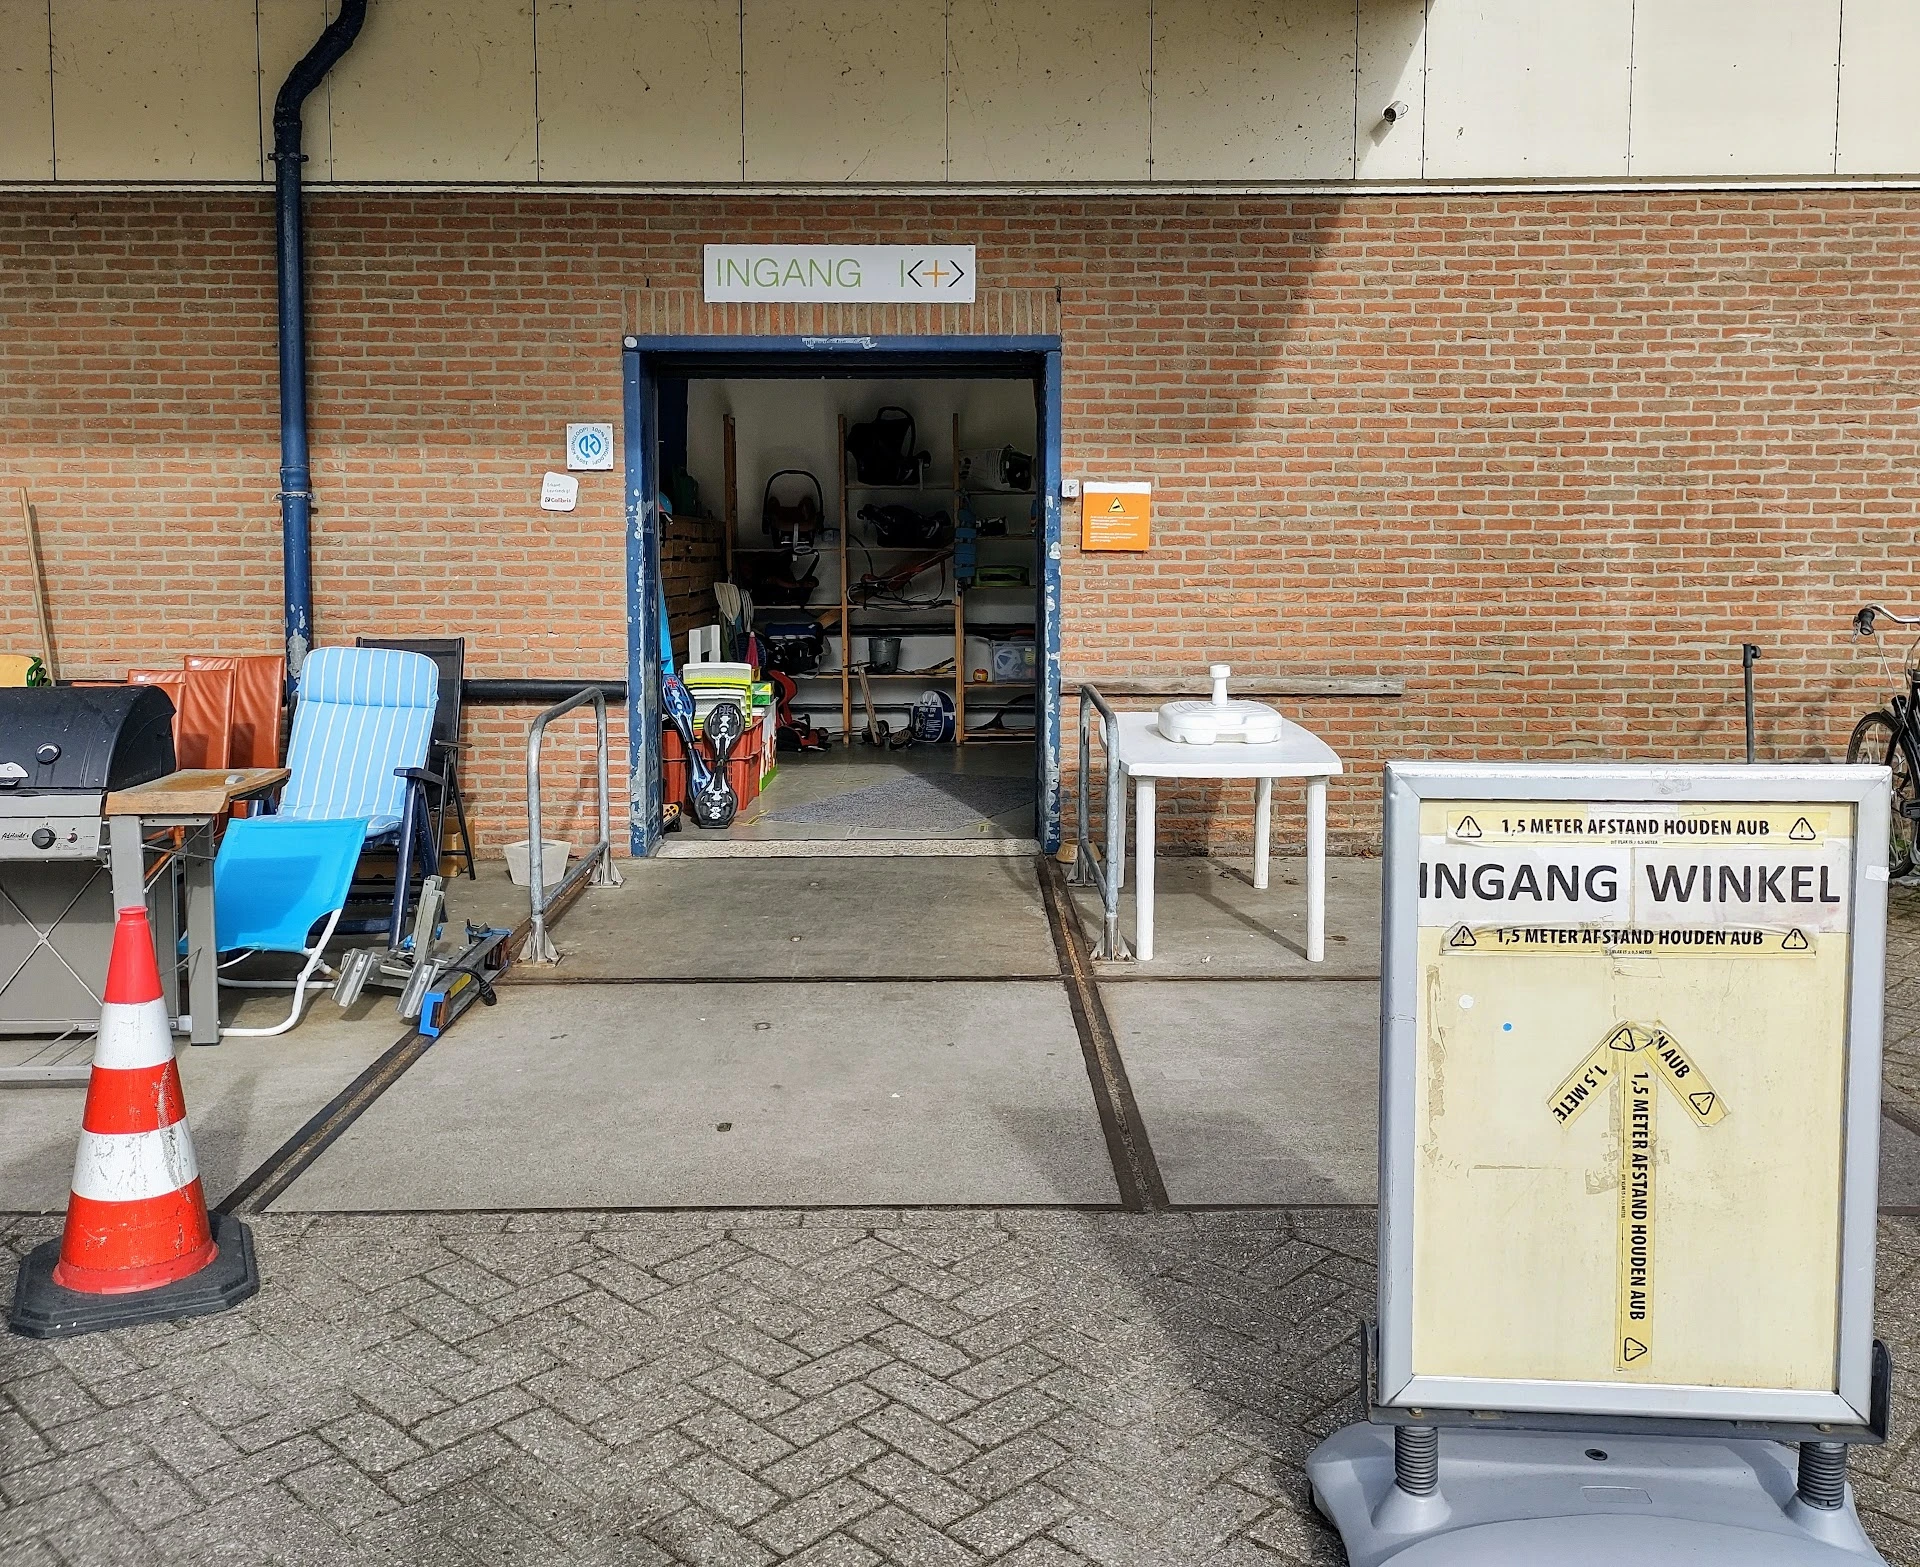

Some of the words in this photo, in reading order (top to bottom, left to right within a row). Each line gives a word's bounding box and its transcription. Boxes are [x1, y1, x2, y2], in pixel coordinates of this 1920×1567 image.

[717, 258, 861, 288] INGANG
[1502, 819, 1526, 836] 1,5
[1530, 819, 1583, 834] METER
[1587, 819, 1659, 835] AFSTAND
[1664, 820, 1732, 836] HOUDEN
[1736, 820, 1770, 836] AUB
[1418, 863, 1617, 902] INGANG
[1645, 865, 1841, 903] WINKEL
[1496, 929, 1520, 946] 1,5
[1525, 929, 1578, 944] METER
[1582, 929, 1654, 945] AFSTAND
[1658, 930, 1726, 945] HOUDEN
[1730, 930, 1763, 946] AUB
[1584, 1064, 1608, 1089] 1,5
[1660, 1049, 1690, 1079] AUB
[1631, 1072, 1648, 1094] 1,5
[1552, 1083, 1589, 1124] METE
[1632, 1100, 1648, 1149] METER
[1631, 1153, 1648, 1220] AFSTAND
[1630, 1224, 1648, 1288] HOUDEN
[1629, 1290, 1646, 1320] AUB
